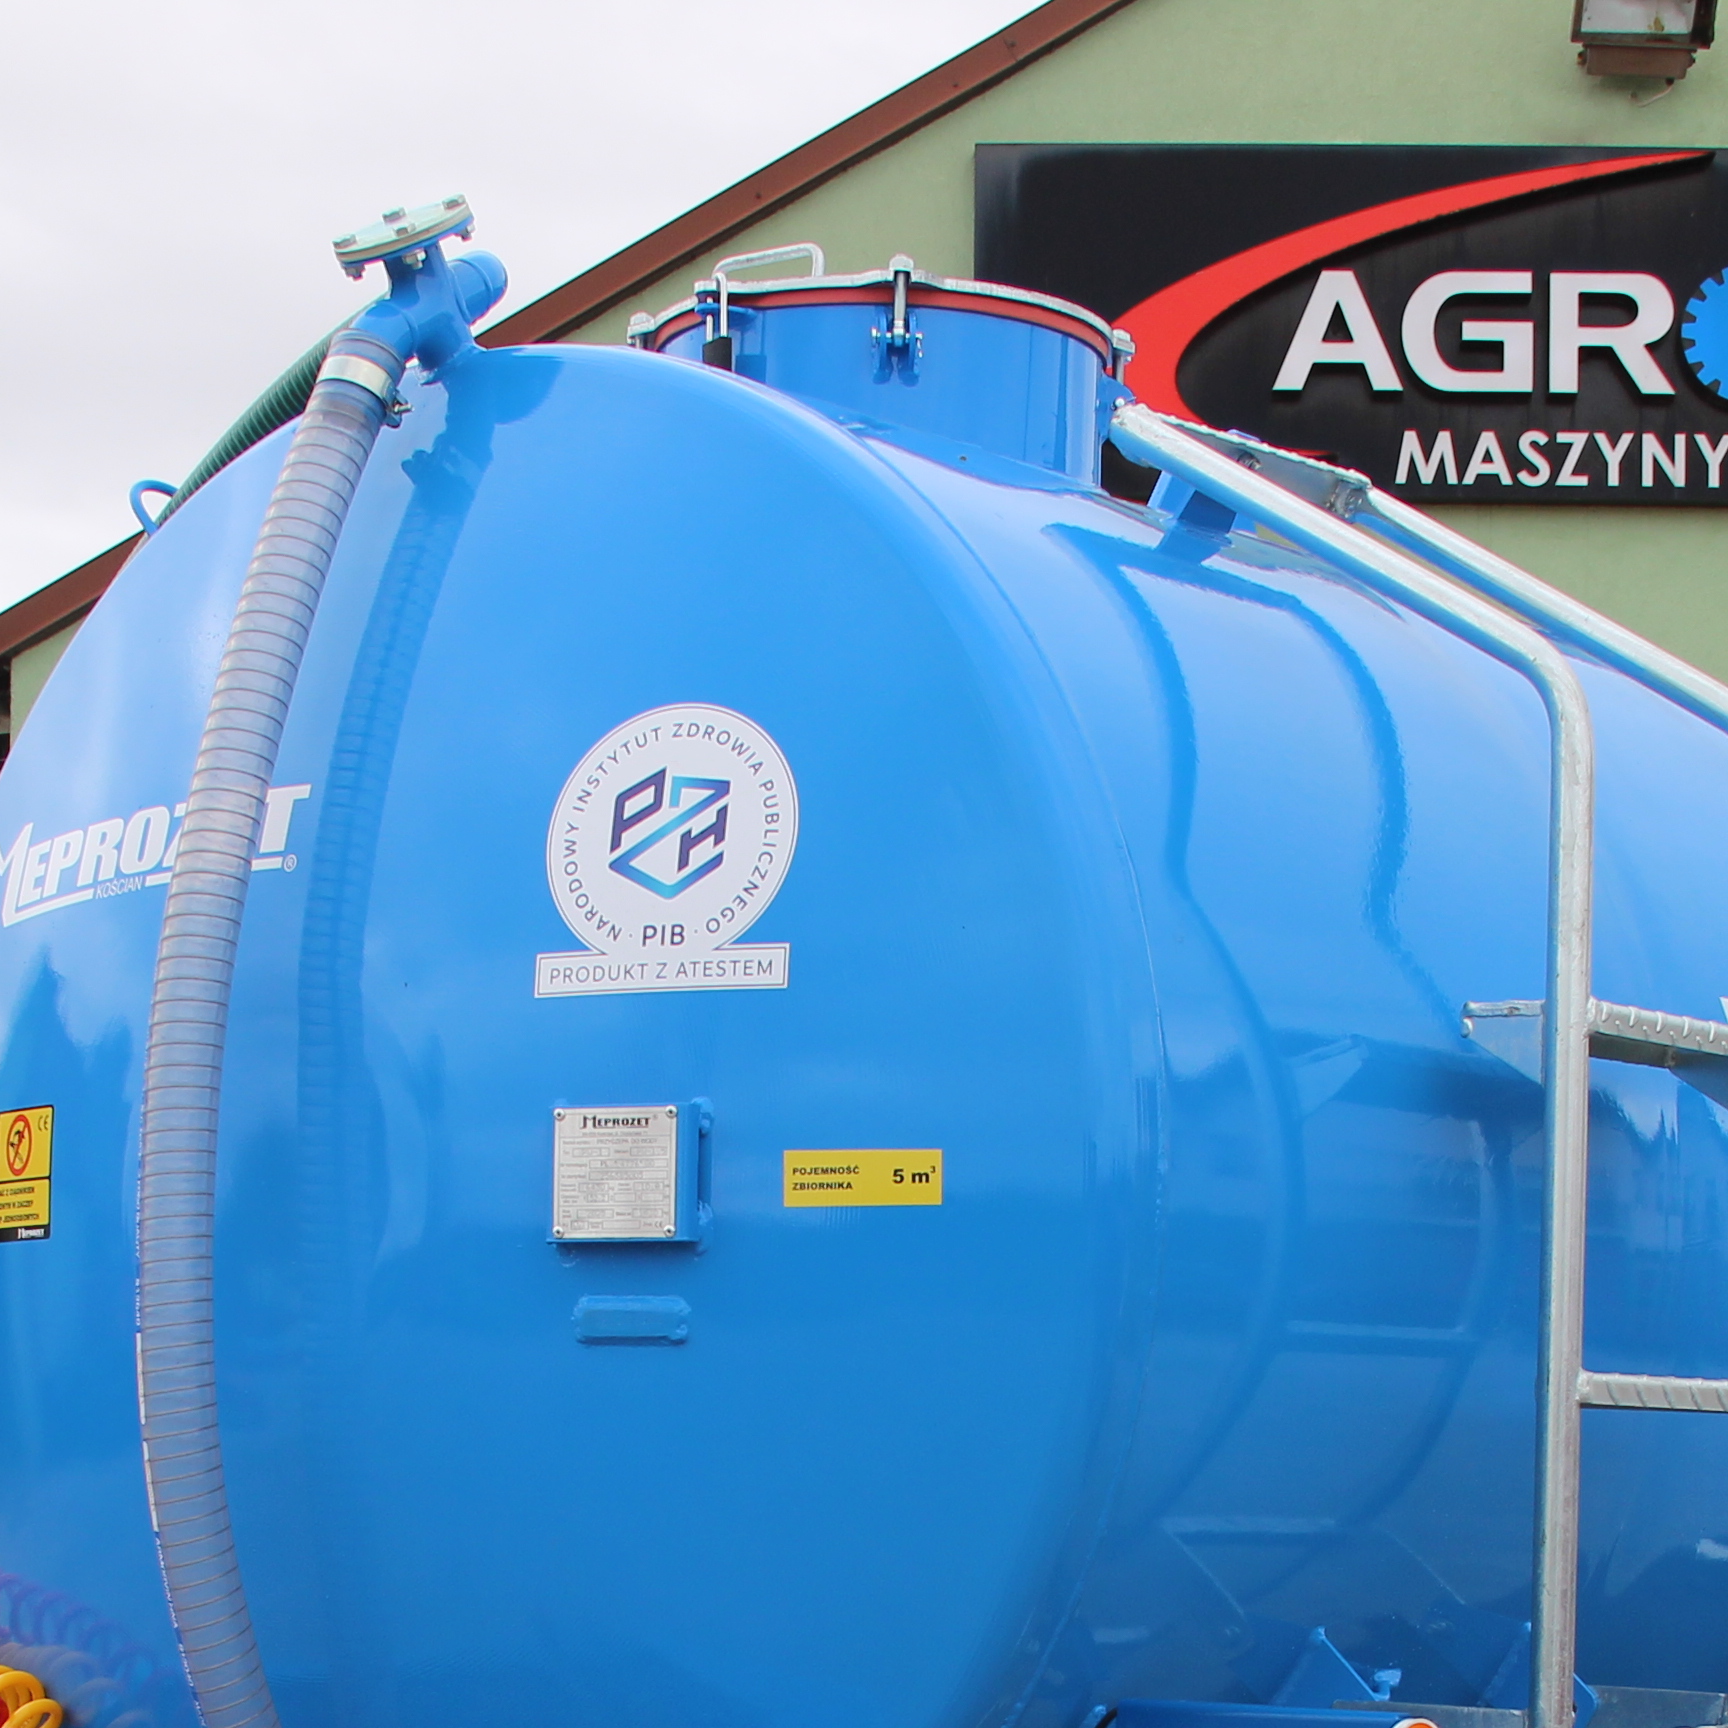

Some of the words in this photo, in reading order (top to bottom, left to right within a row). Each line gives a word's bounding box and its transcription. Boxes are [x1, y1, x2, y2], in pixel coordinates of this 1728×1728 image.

[671, 722, 765, 777] ZDROWIA
[572, 726, 662, 813] INSTYTUT
[705, 779, 780, 935] PUBLICZNEGO
[94, 875, 144, 900] KOŚCIAN
[563, 821, 622, 943] NARODOWY
[641, 923, 686, 947] PIB
[549, 962, 649, 985] PRODUKT
[655, 962, 668, 980] Z
[674, 958, 774, 980] ATESTEM
[579, 1114, 652, 1130] MEPROZET
[792, 1165, 860, 1176] POJEMNOŚĆ
[892, 1168, 905, 1184] 5
[792, 1181, 854, 1191] ZBIORNIKA
